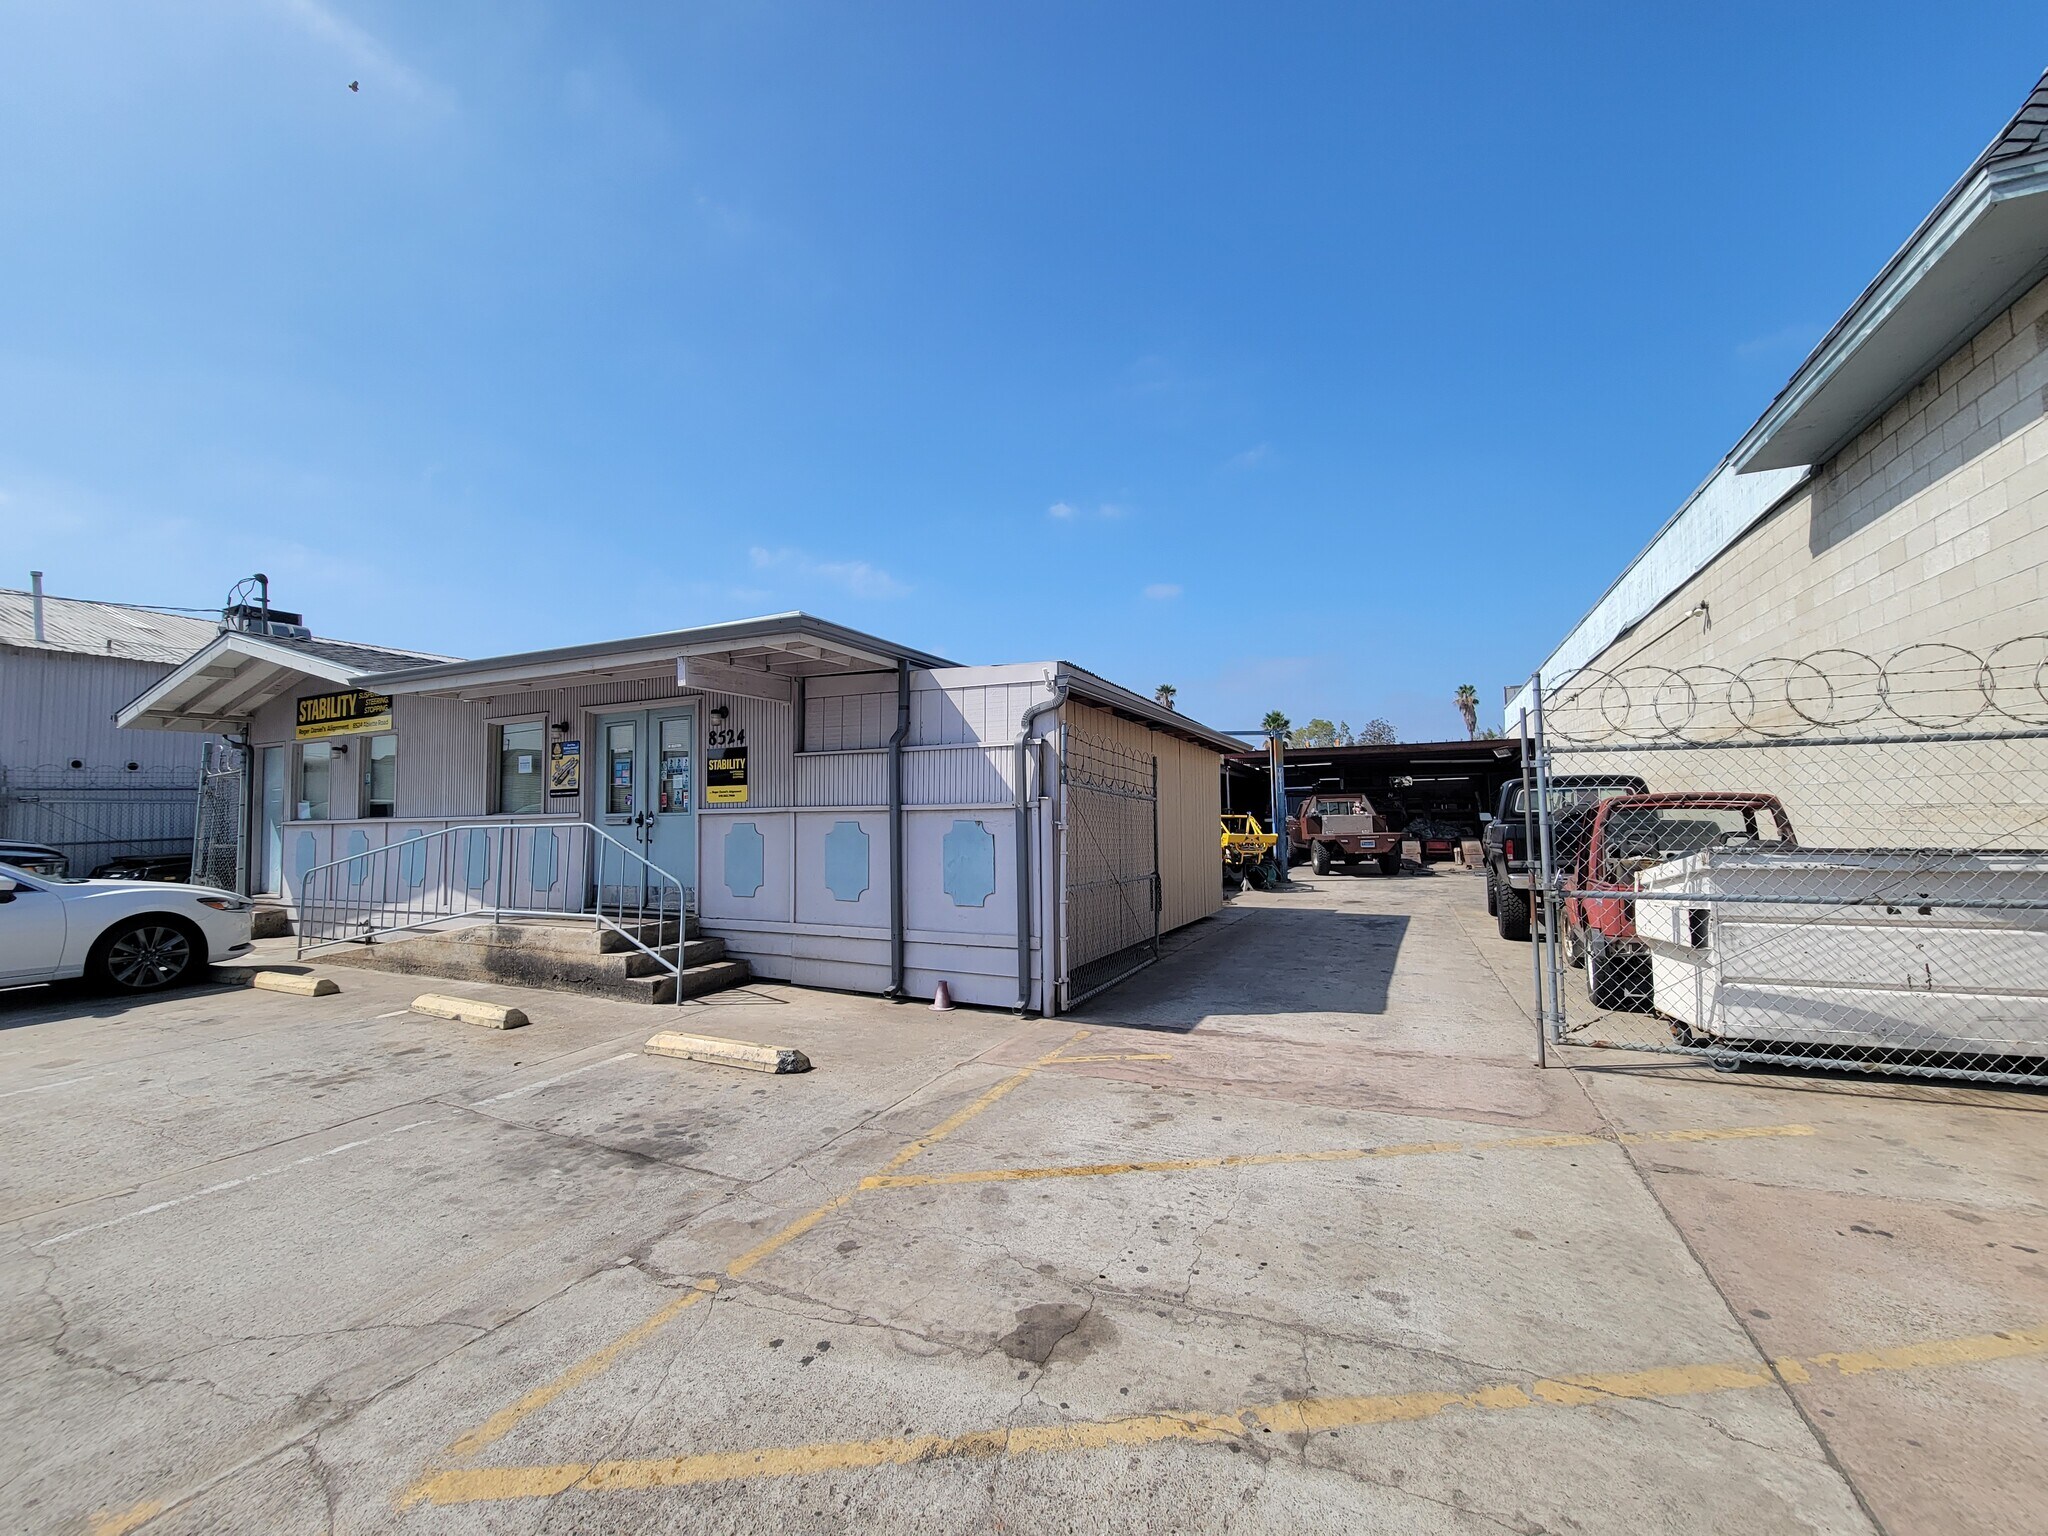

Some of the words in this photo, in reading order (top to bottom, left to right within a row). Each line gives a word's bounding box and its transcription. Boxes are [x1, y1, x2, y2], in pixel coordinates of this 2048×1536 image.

[300, 693, 357, 722] STABILITY
[298, 728, 310, 736] Roger
[327, 723, 350, 732] Alignment
[708, 728, 745, 746] 8524
[708, 758, 746, 771] STABILITY
